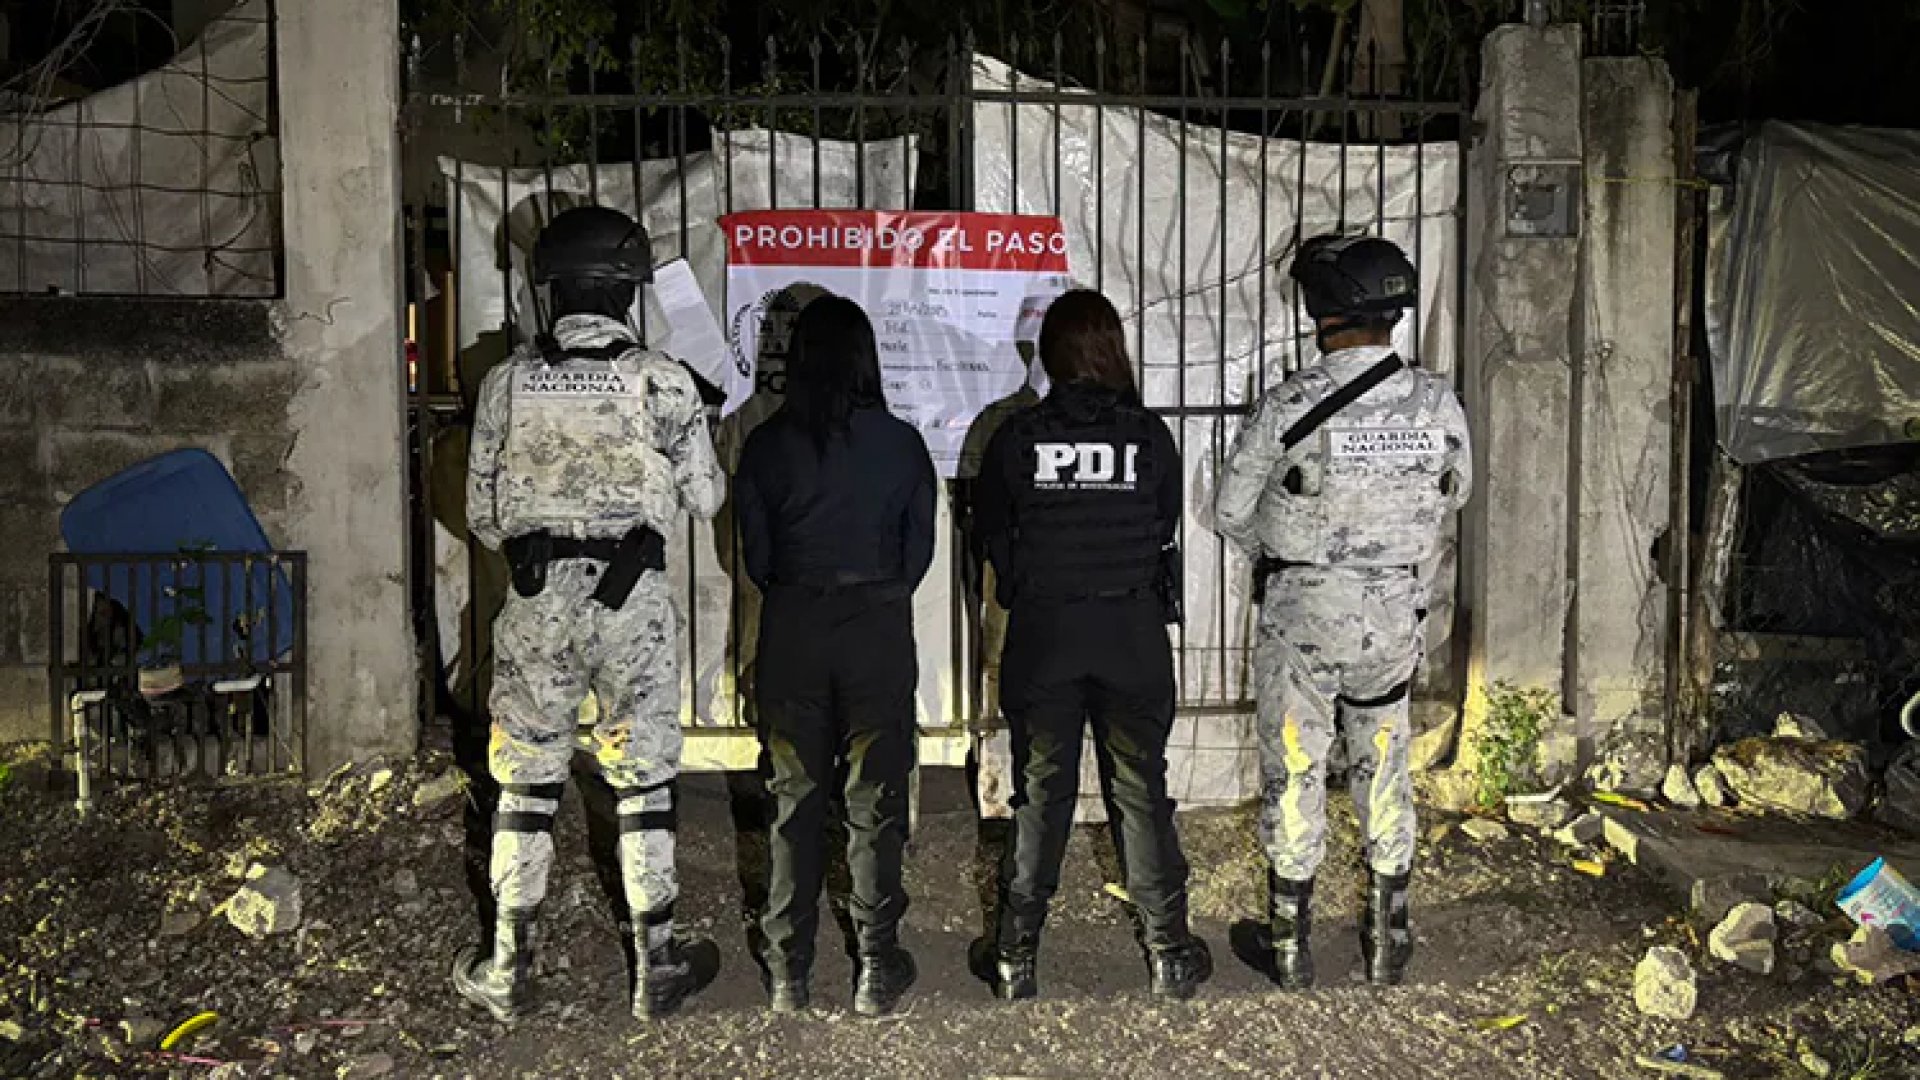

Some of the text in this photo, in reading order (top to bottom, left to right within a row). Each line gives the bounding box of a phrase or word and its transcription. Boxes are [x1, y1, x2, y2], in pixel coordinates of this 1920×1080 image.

[735, 224, 1066, 254] PROHIBIDO EL PASO
[521, 382, 632, 393] NACIONAL
[1348, 431, 1430, 443] GUARDIA
[1342, 441, 1437, 453] NACIONAL
[1033, 442, 1139, 482] PDI
